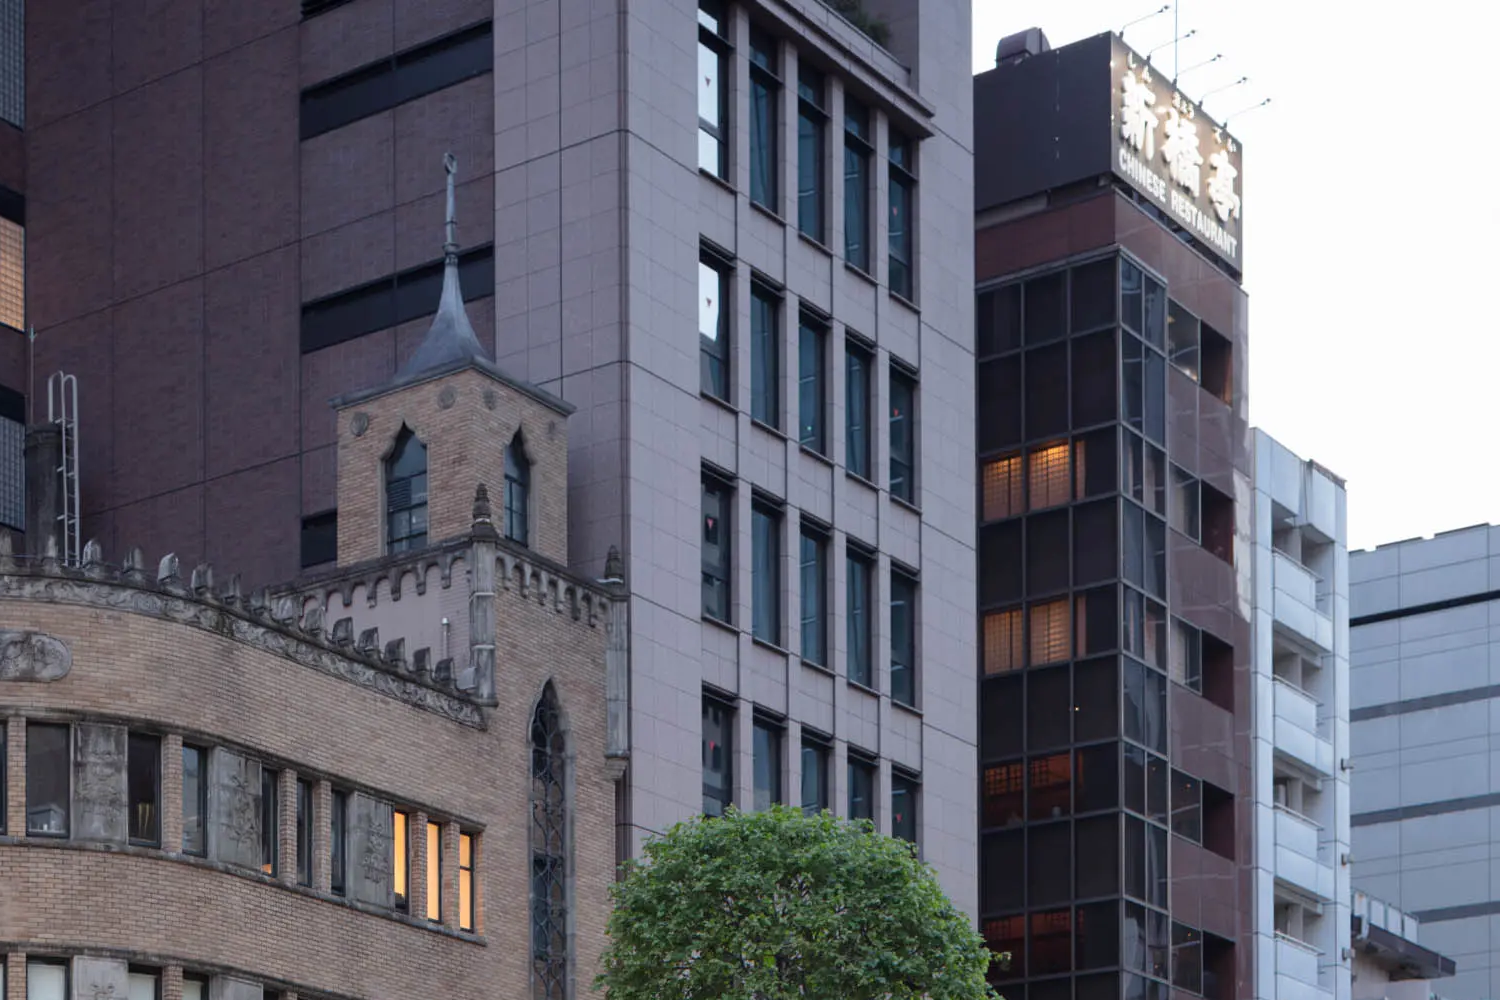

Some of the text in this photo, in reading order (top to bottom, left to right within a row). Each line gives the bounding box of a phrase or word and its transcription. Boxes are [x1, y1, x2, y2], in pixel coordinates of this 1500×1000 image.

[1118, 147, 1239, 259] CHINESE RESTAURANT
[1120, 68, 1241, 224] 新橋亭
